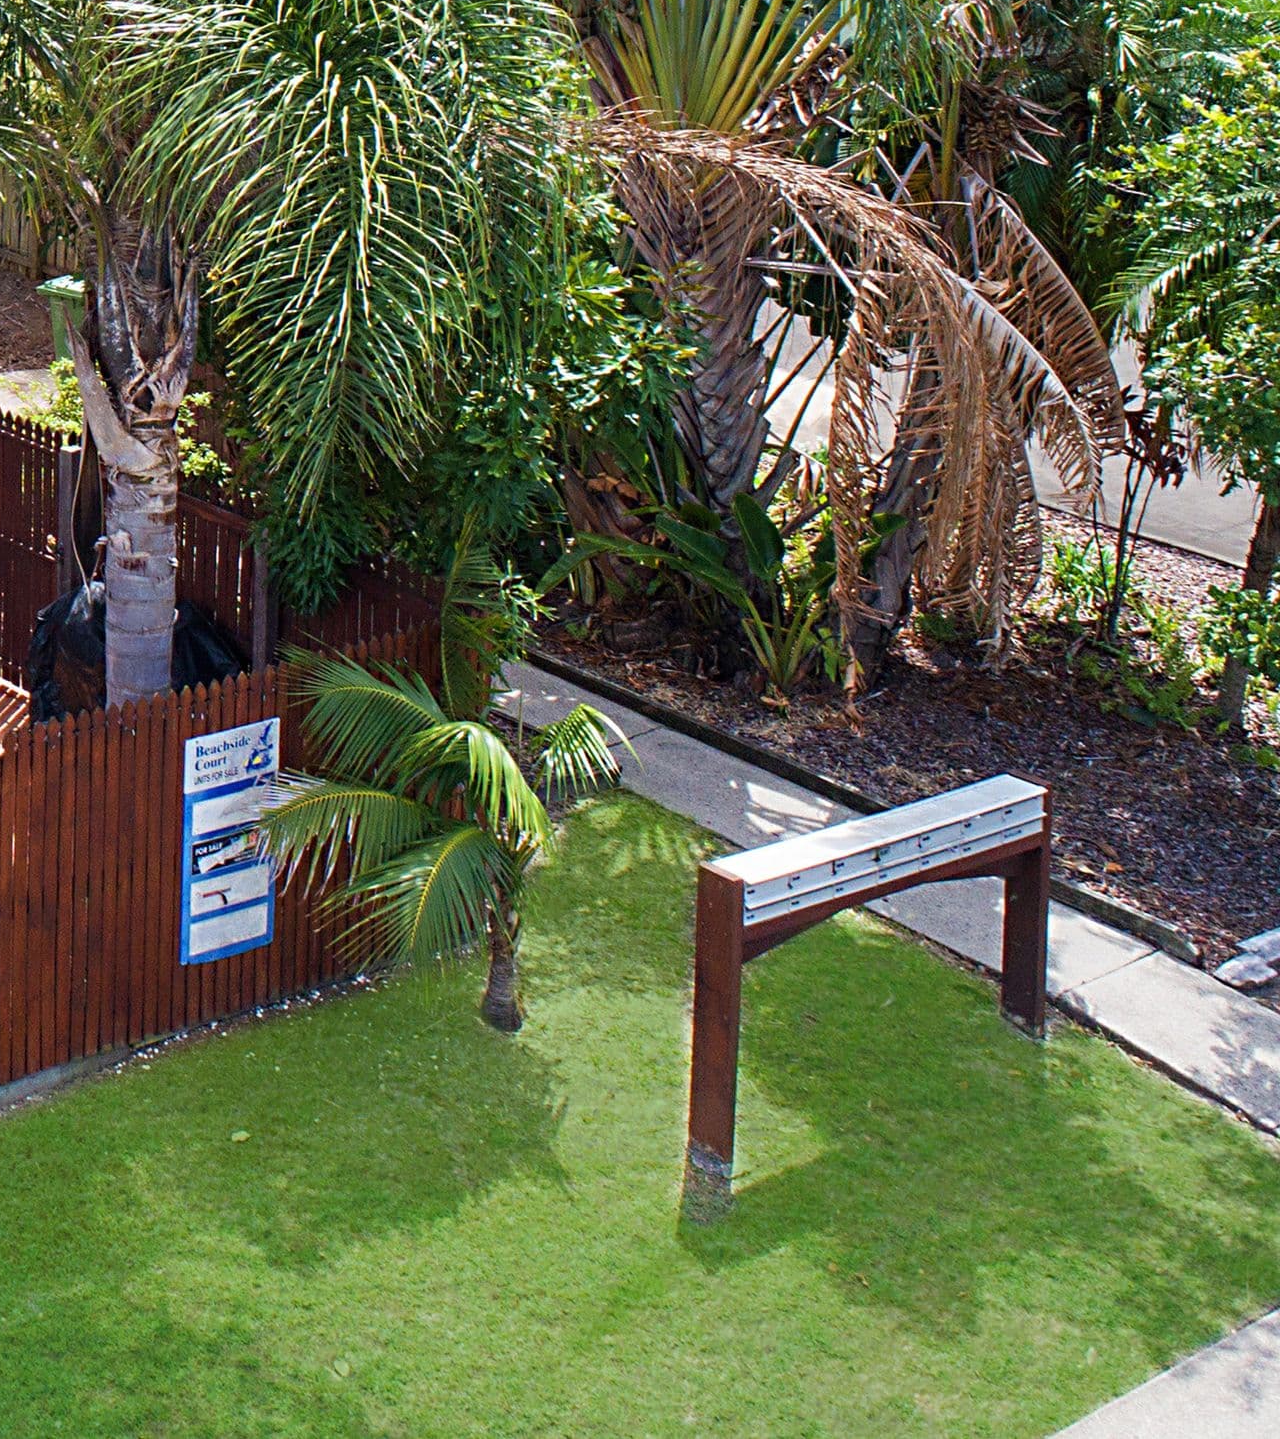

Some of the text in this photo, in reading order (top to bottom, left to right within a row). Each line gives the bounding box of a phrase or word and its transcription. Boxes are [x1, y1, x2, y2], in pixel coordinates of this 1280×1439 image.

[196, 736, 251, 758] Beachside
[195, 756, 227, 771] Court
[212, 771, 223, 780] FOR
[224, 767, 239, 777] SALE
[195, 846, 208, 856] FOR
